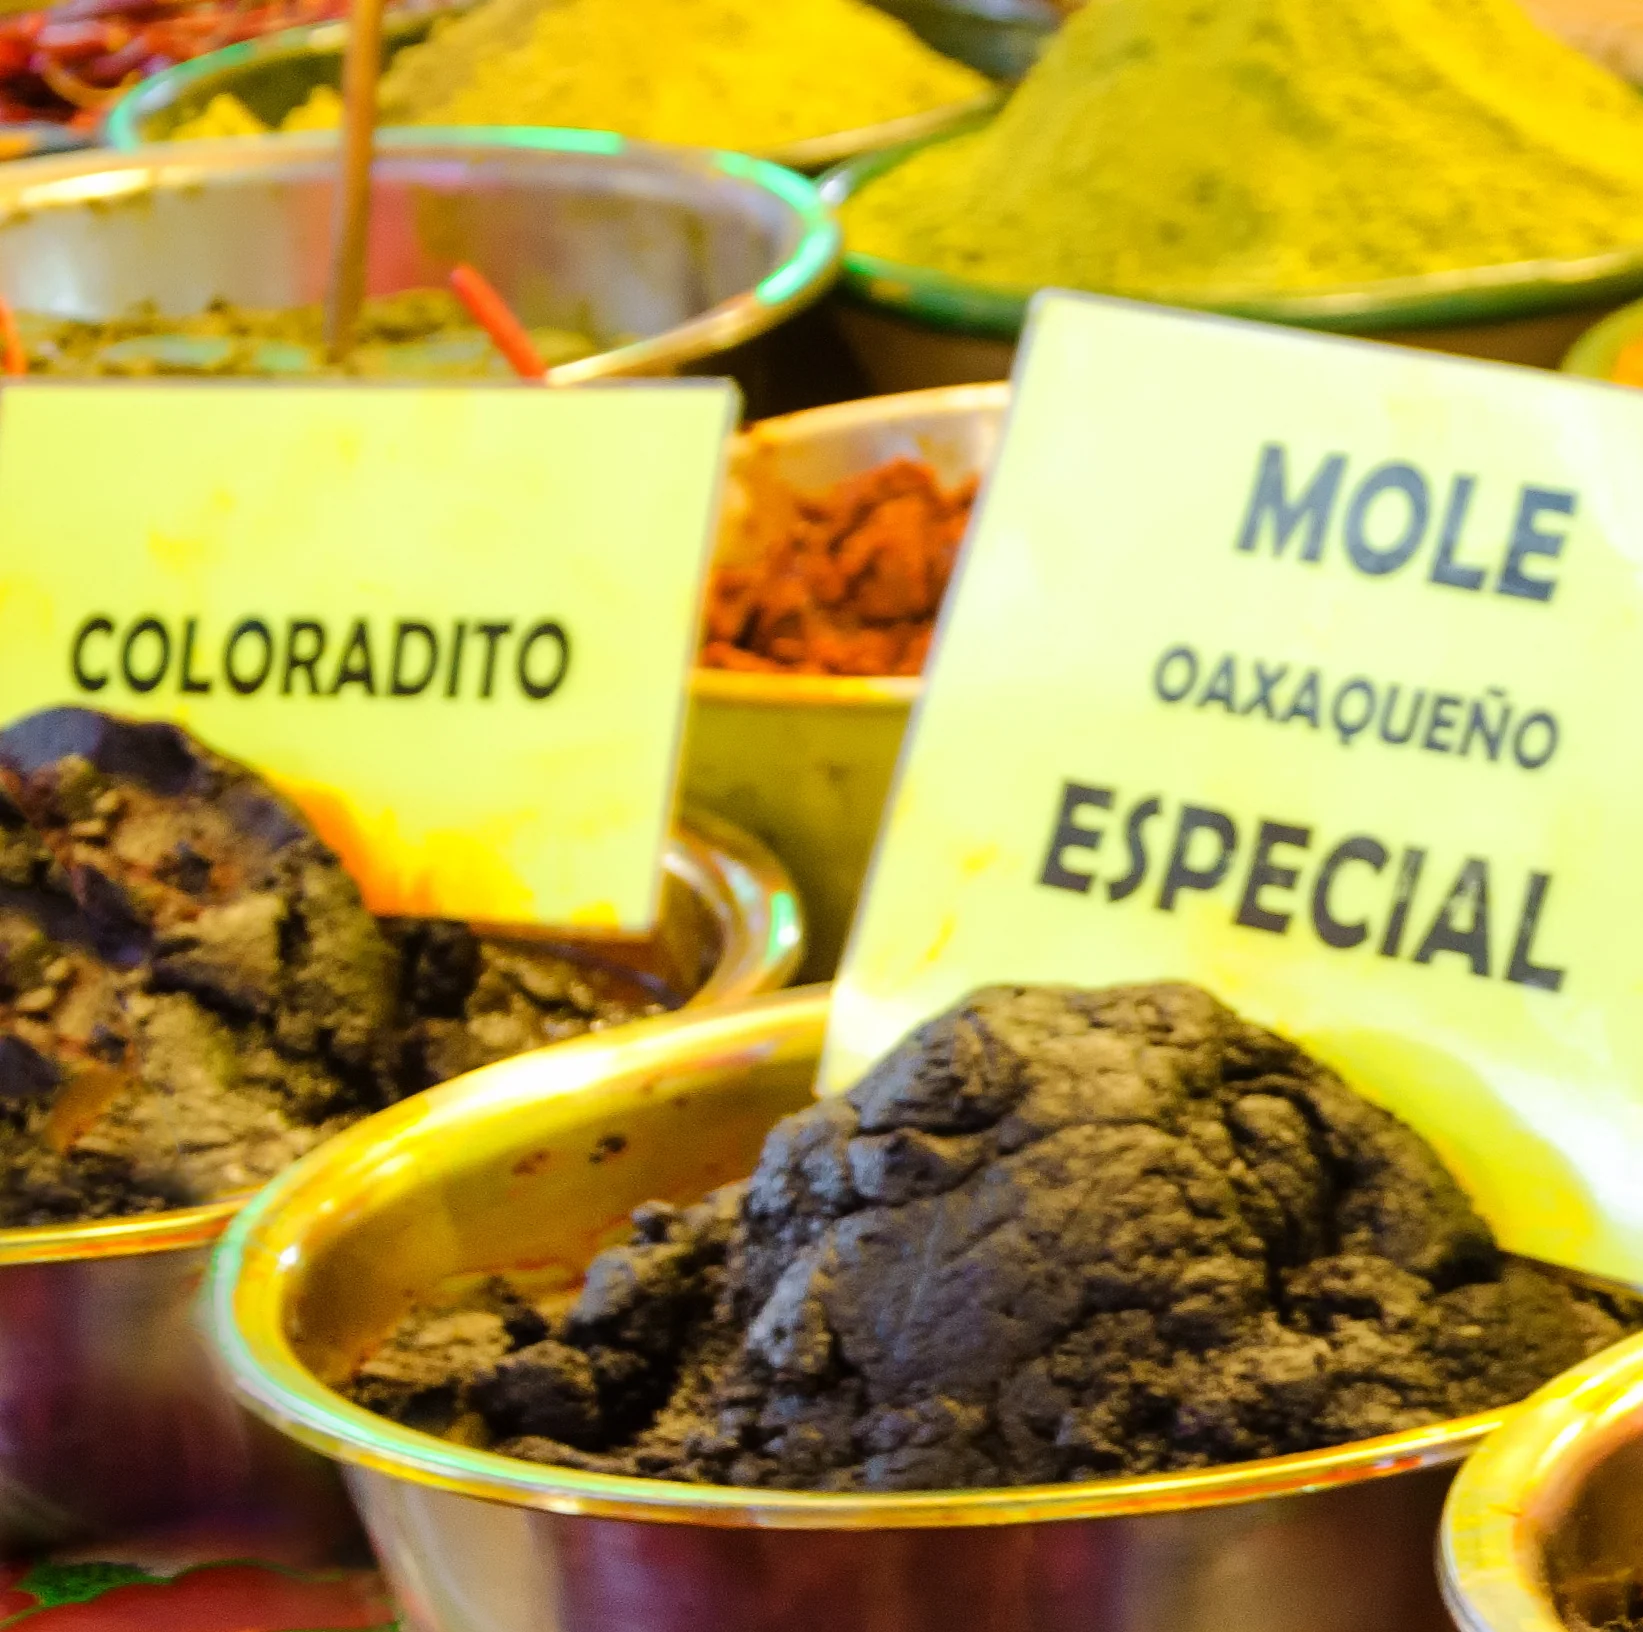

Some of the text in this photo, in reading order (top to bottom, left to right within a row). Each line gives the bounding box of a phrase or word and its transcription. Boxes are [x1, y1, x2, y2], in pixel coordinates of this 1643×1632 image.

[1237, 444, 1575, 602] MOLE
[71, 615, 570, 699] COLORADITO
[1154, 645, 1558, 770] OAXAQUEÑO
[1037, 780, 1566, 992] ESPECIAL
